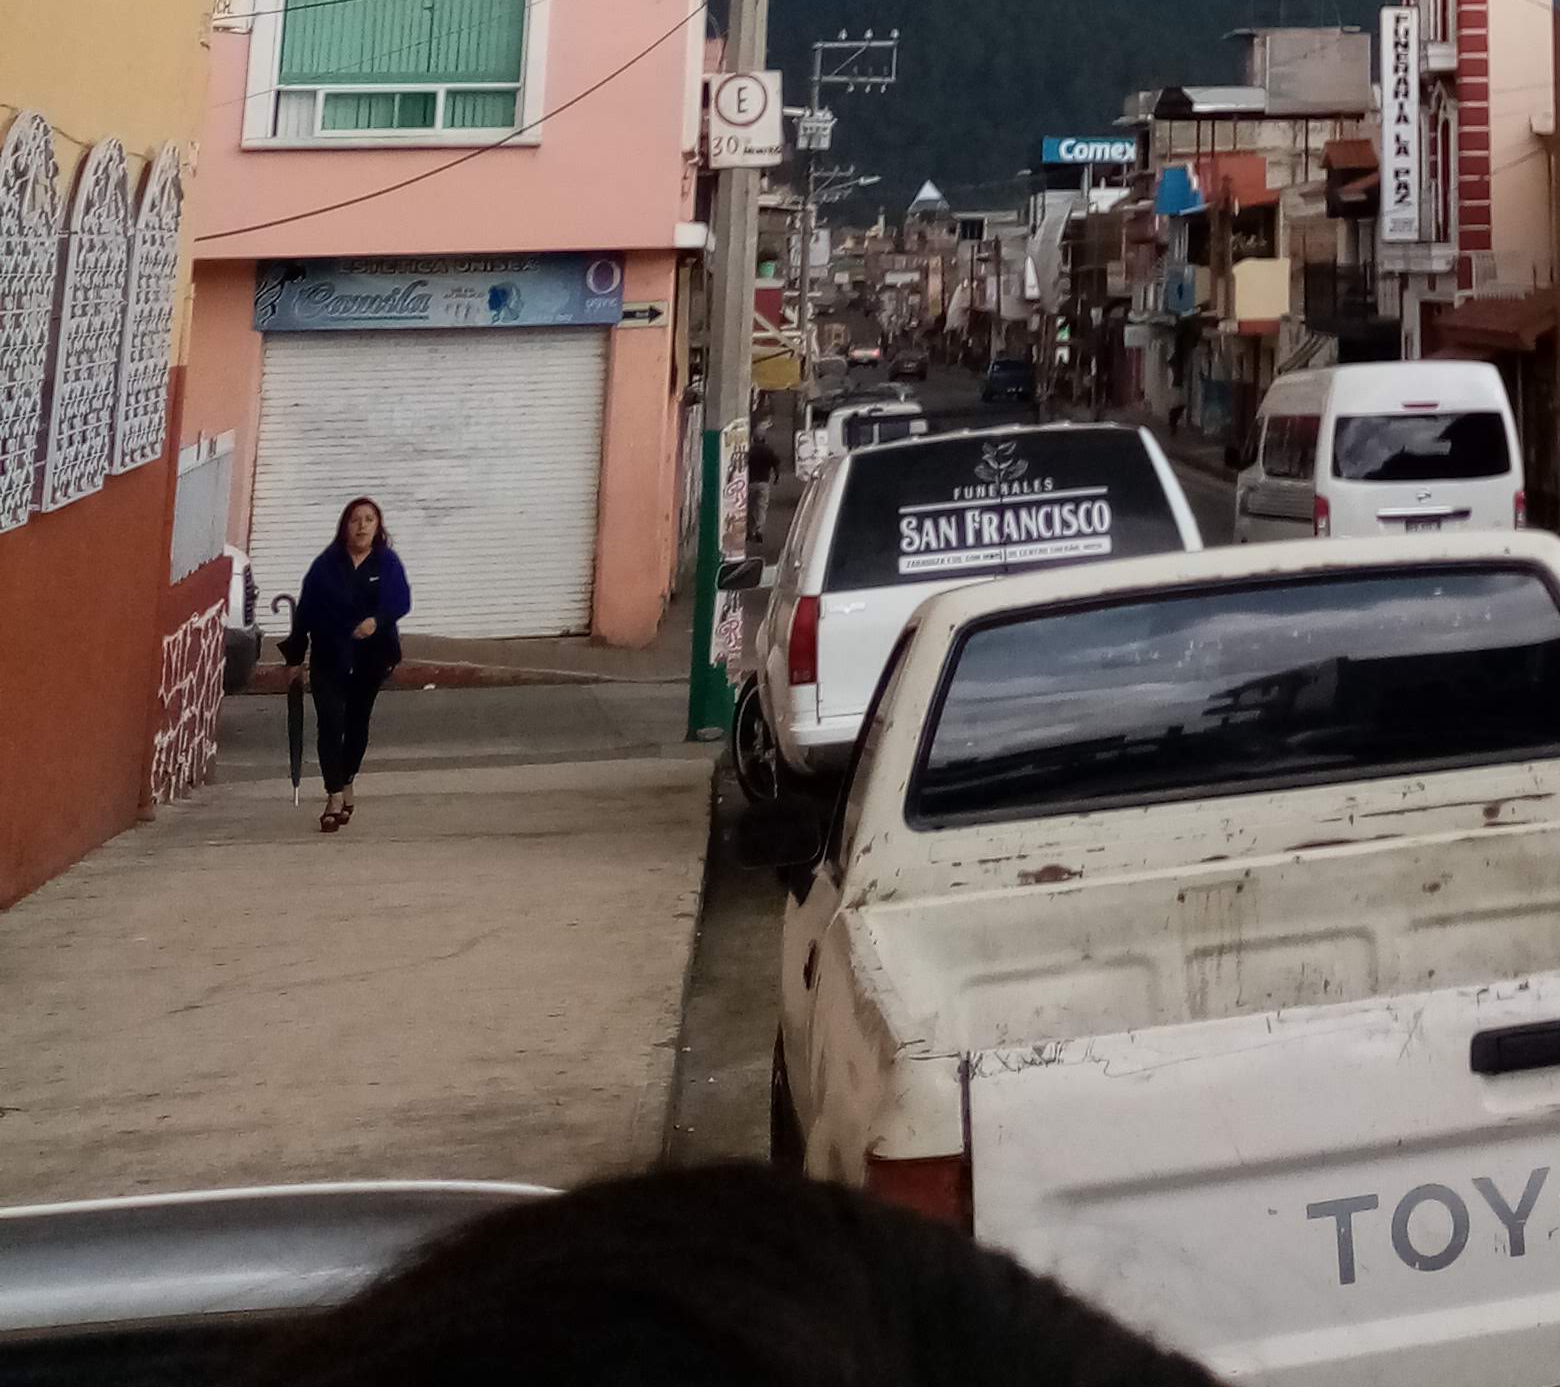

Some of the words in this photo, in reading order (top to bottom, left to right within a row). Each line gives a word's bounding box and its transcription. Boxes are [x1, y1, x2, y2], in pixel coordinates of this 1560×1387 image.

[1392, 15, 1411, 125] FUNERARIA
[737, 86, 749, 114] E
[712, 134, 739, 157] 30
[1058, 138, 1137, 162] Comex
[1394, 133, 1411, 157] LA
[1393, 167, 1412, 206] PAZ
[294, 280, 431, 317] Camila
[953, 477, 1053, 500] FUNERALES
[900, 514, 958, 553] SAN
[964, 499, 1112, 547] FRANCISCO
